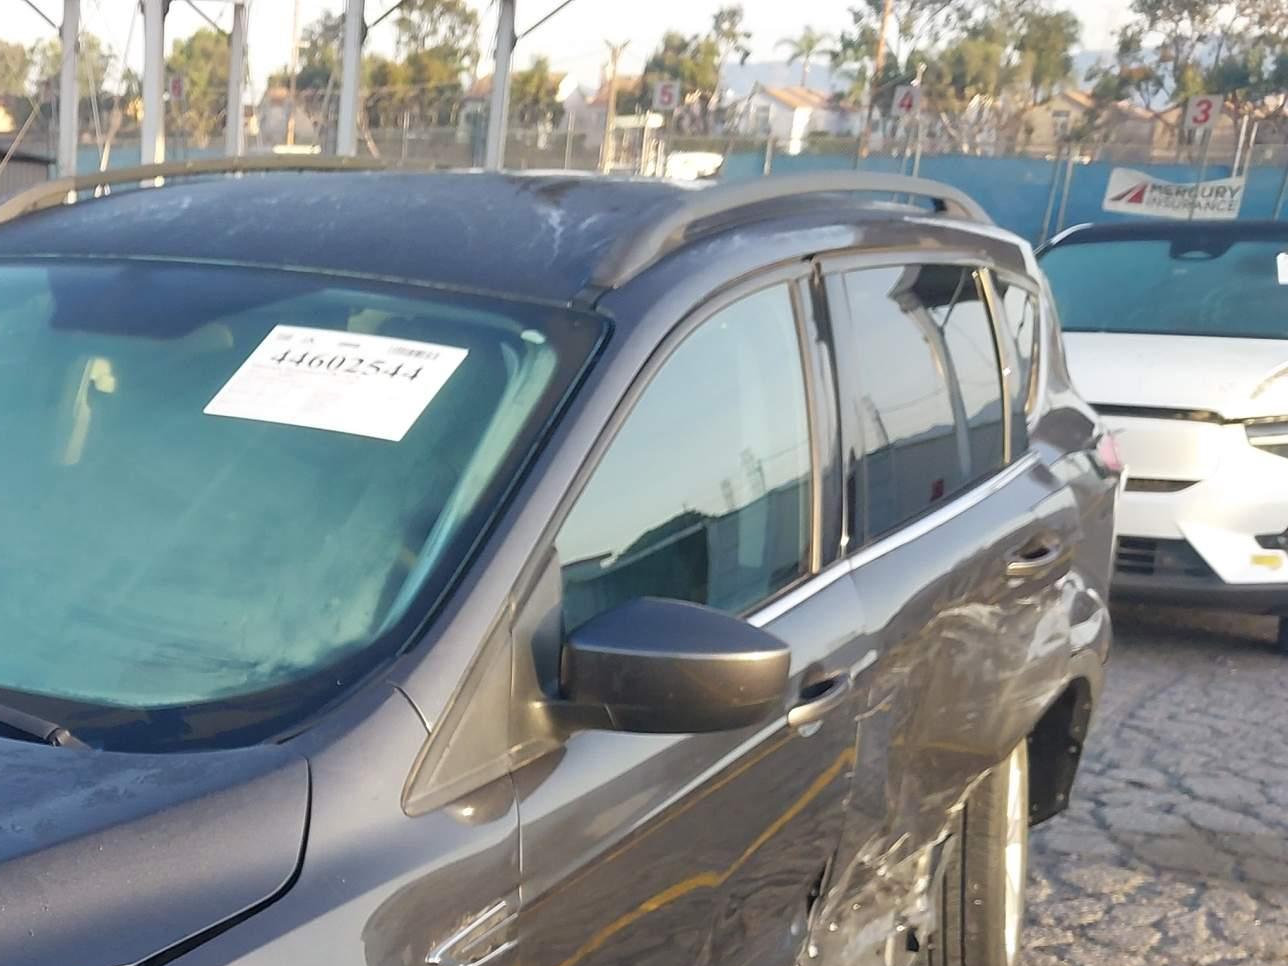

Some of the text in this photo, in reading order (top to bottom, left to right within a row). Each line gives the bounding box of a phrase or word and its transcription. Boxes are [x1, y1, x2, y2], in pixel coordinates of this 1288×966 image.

[660, 84, 674, 106] 5
[898, 90, 914, 113] 4
[1192, 98, 1213, 125] 3
[1144, 192, 1238, 212] INSURANCE
[1150, 183, 1242, 200] MERCURY
[270, 348, 424, 383] 44602544
